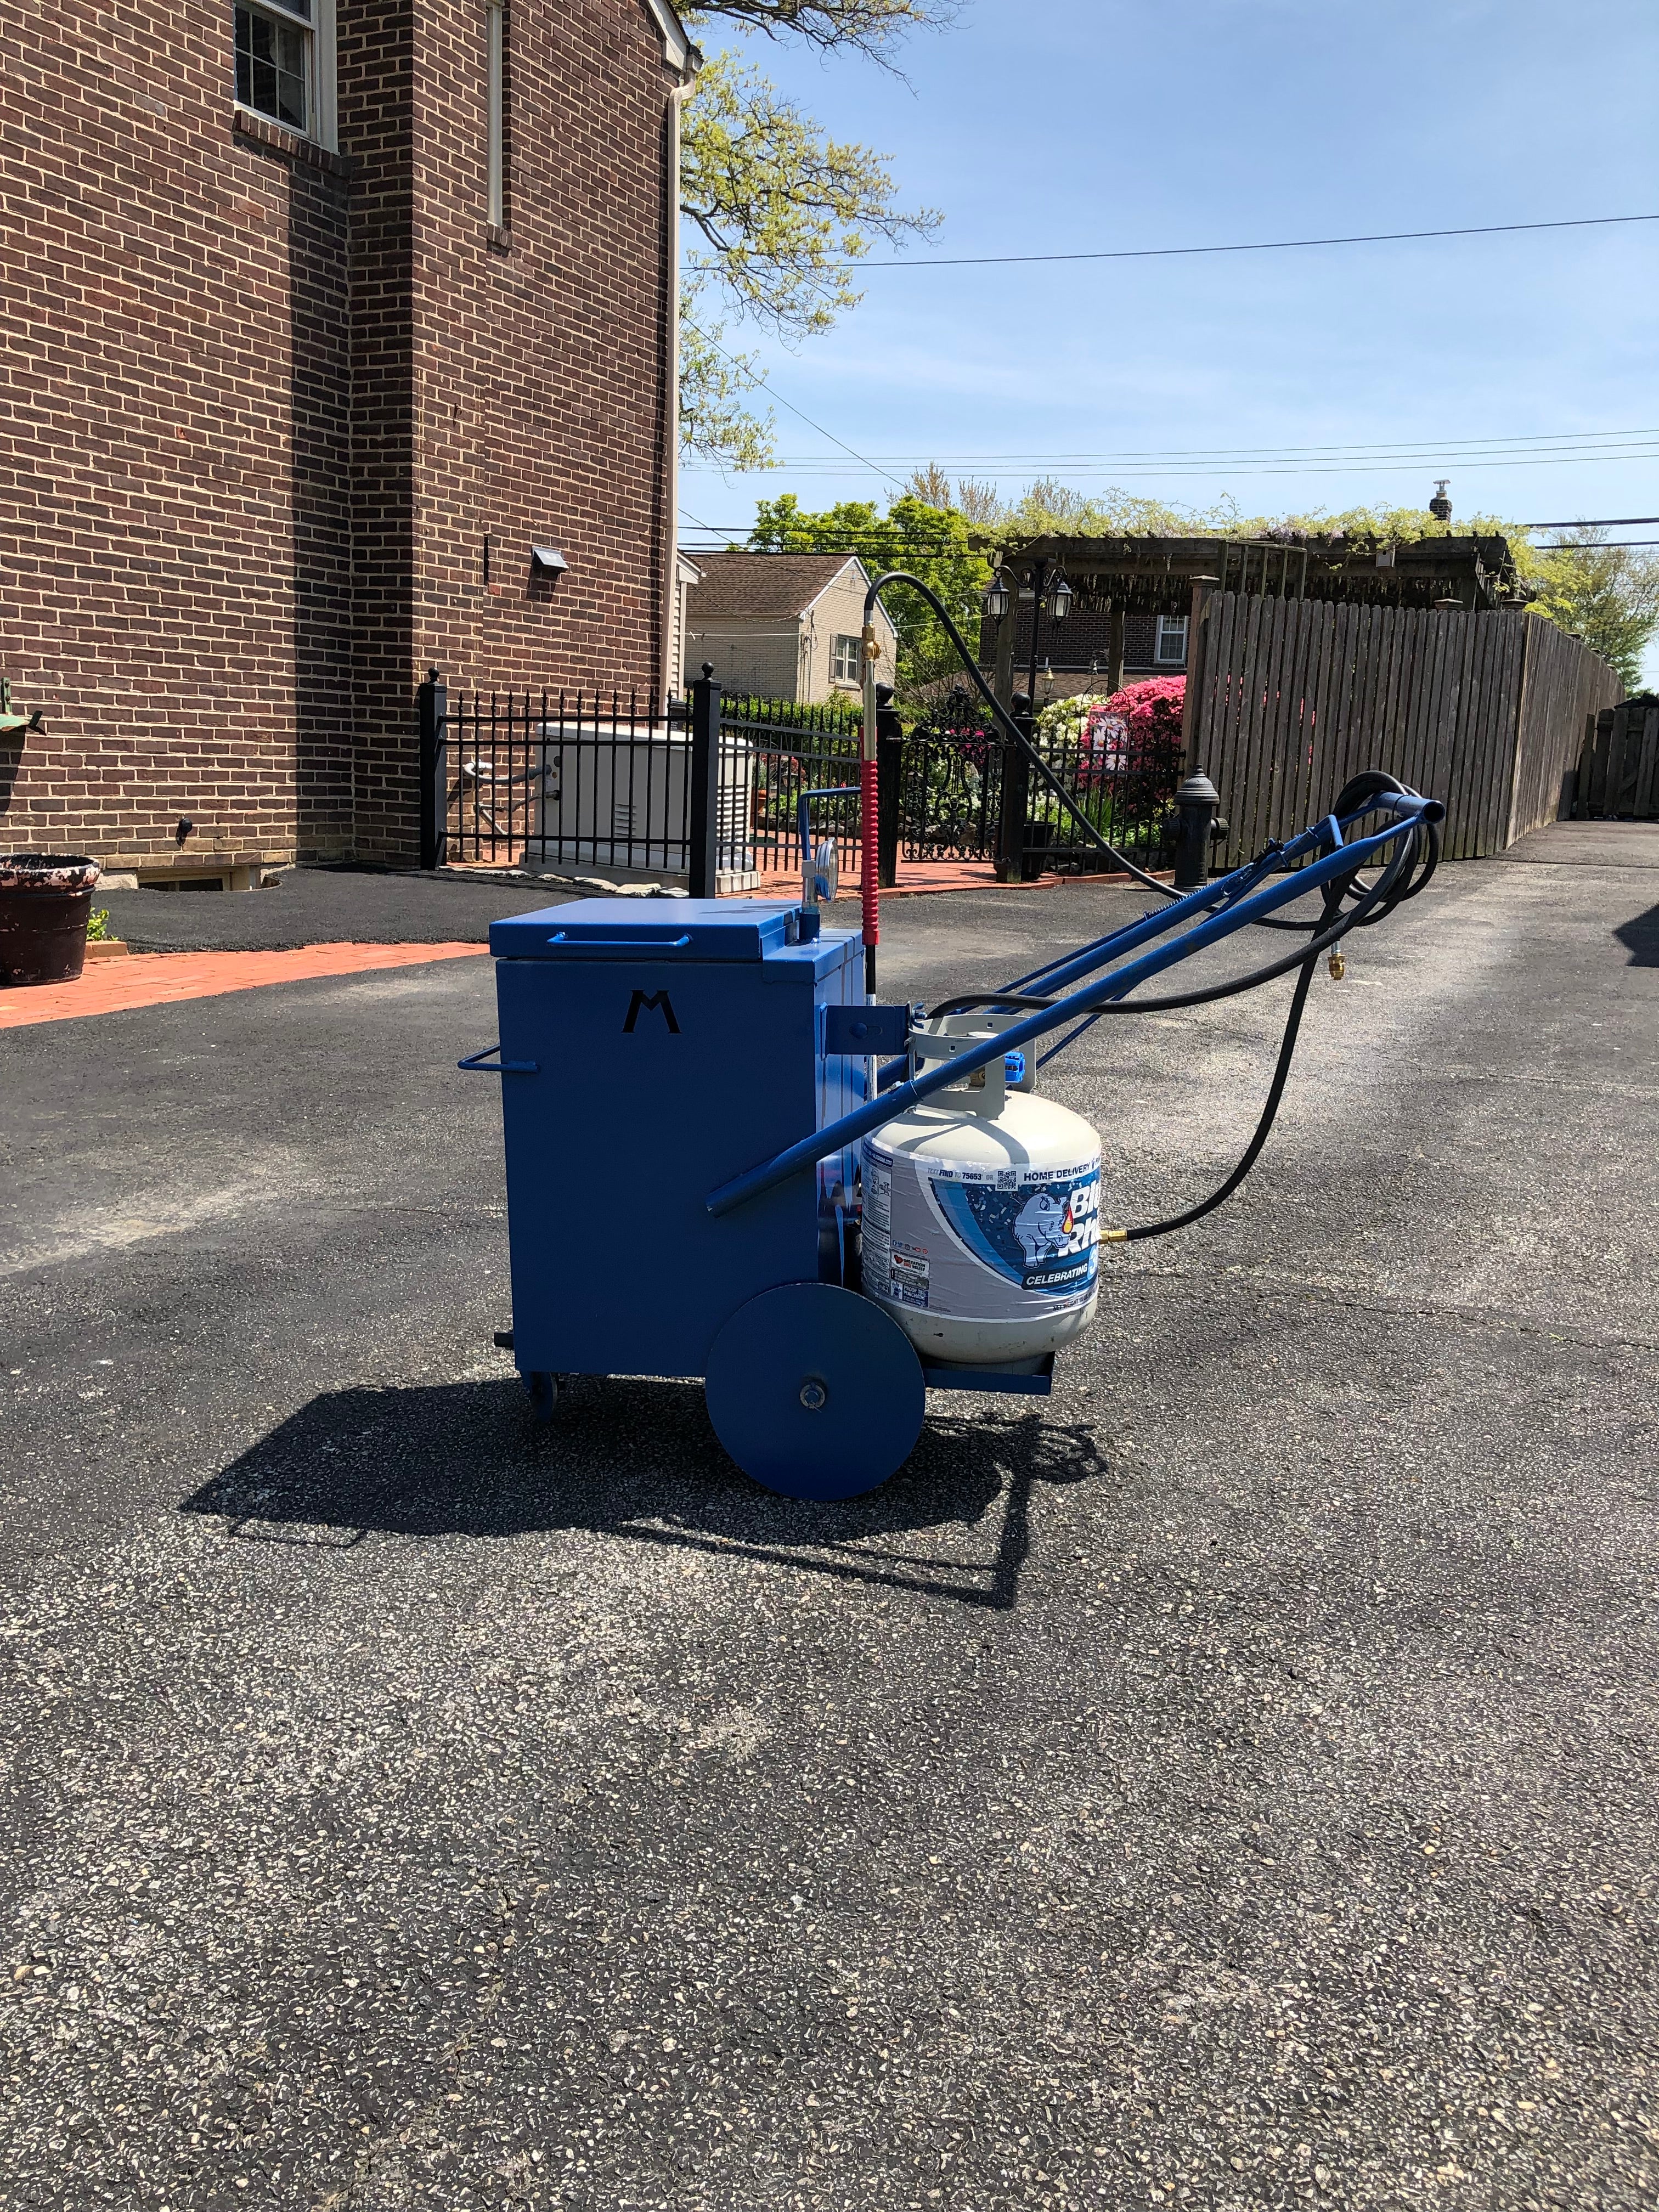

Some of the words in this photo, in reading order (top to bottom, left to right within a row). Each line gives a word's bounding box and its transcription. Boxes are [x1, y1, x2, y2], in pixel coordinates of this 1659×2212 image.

[620, 989, 683, 1034] M
[939, 1169, 953, 1178] FIND
[1024, 1171, 1054, 1181] HOME
[1056, 1161, 1091, 1178] DELIVERY
[1026, 1263, 1088, 1285] CELEBRATING
